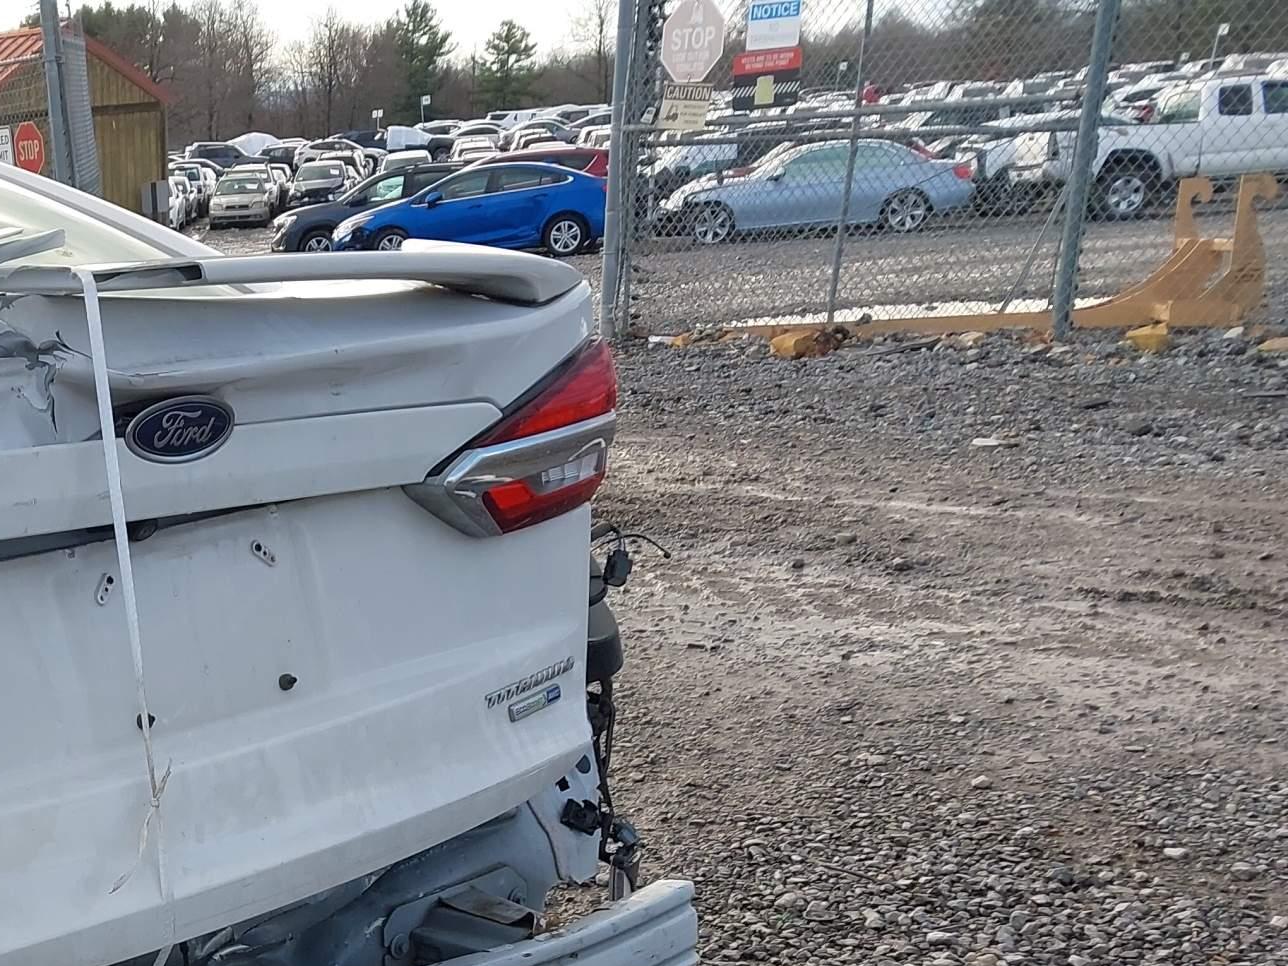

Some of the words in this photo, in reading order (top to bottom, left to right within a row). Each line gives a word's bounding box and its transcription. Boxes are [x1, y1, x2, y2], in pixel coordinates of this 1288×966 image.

[753, 3, 798, 19] NOTICE
[672, 26, 715, 51] STOP
[666, 86, 711, 100] CAUTION
[18, 140, 40, 161] STOP
[154, 410, 216, 448] Ford
